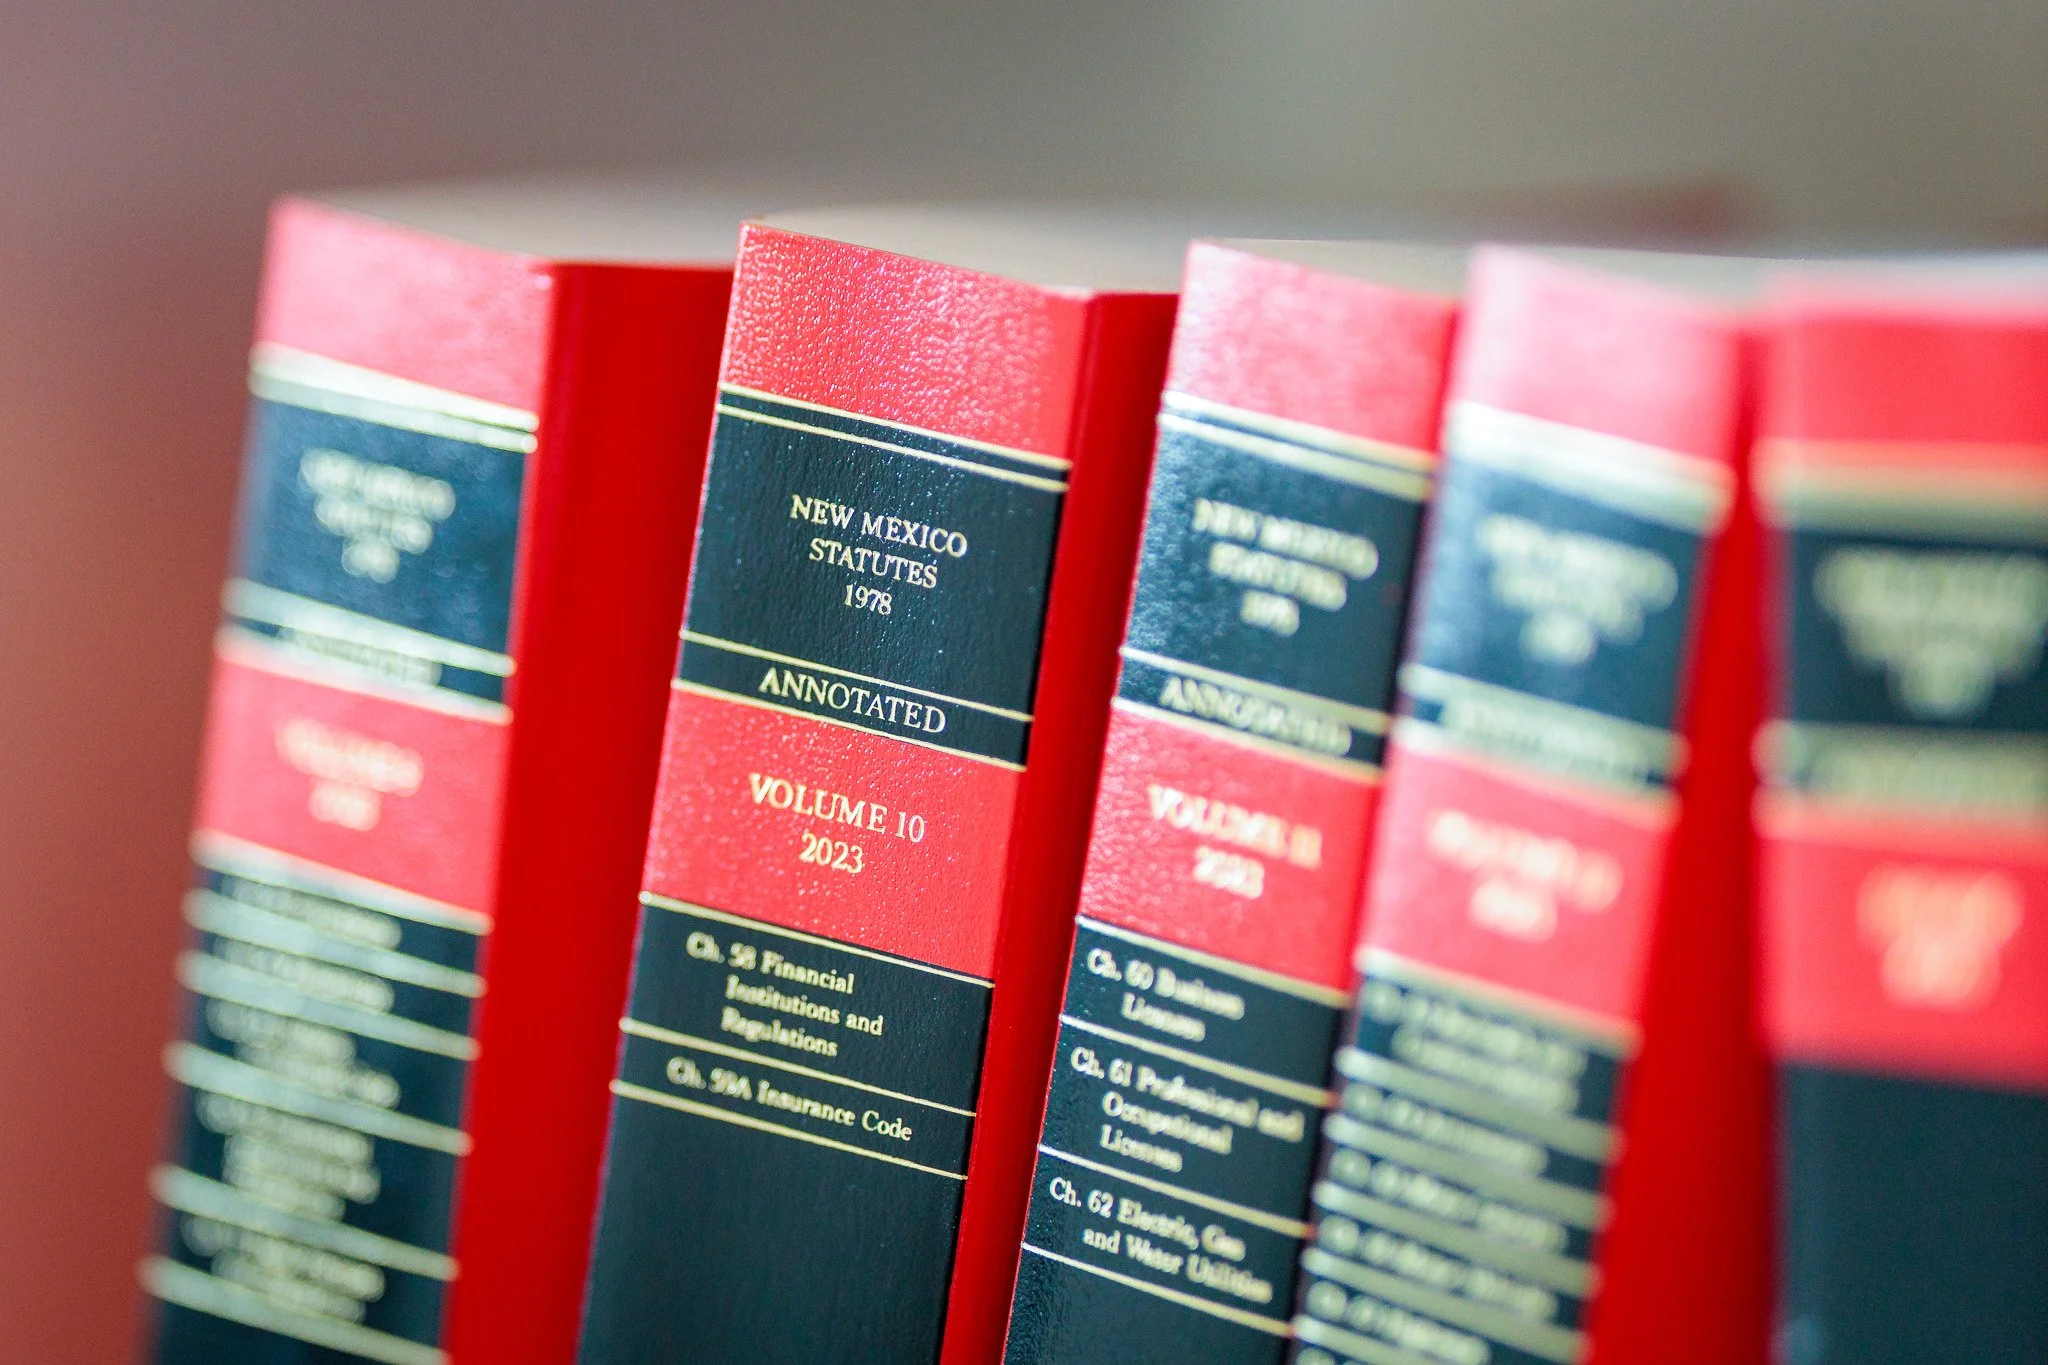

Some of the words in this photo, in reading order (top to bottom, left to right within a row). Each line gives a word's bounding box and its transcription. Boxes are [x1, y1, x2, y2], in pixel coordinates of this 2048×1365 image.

[789, 494, 854, 530] NEW
[860, 510, 968, 558] MEXICO
[808, 537, 938, 589] STATUTES
[843, 584, 893, 616] 1978
[758, 666, 947, 734] ANNOTATED
[749, 772, 888, 834] VOLUME
[894, 811, 926, 843] 10
[799, 832, 865, 874] 2023
[686, 930, 725, 964] Ch.
[728, 942, 757, 970] 58
[761, 949, 855, 995] Financial
[720, 1005, 838, 1058] Regulations
[725, 973, 841, 1025] Institutions
[845, 1010, 883, 1036] and
[1070, 1046, 1105, 1079] Ch.
[1109, 1057, 1133, 1087] 61
[666, 1055, 706, 1090] Ch.
[757, 1079, 856, 1127] Insurance
[861, 1110, 913, 1142] Code
[1050, 1176, 1081, 1208] Ch.
[1087, 1189, 1114, 1218] 62
[1117, 1197, 1199, 1251] Electric,
[1082, 1228, 1121, 1254] and
[1126, 1234, 1183, 1275] Water
